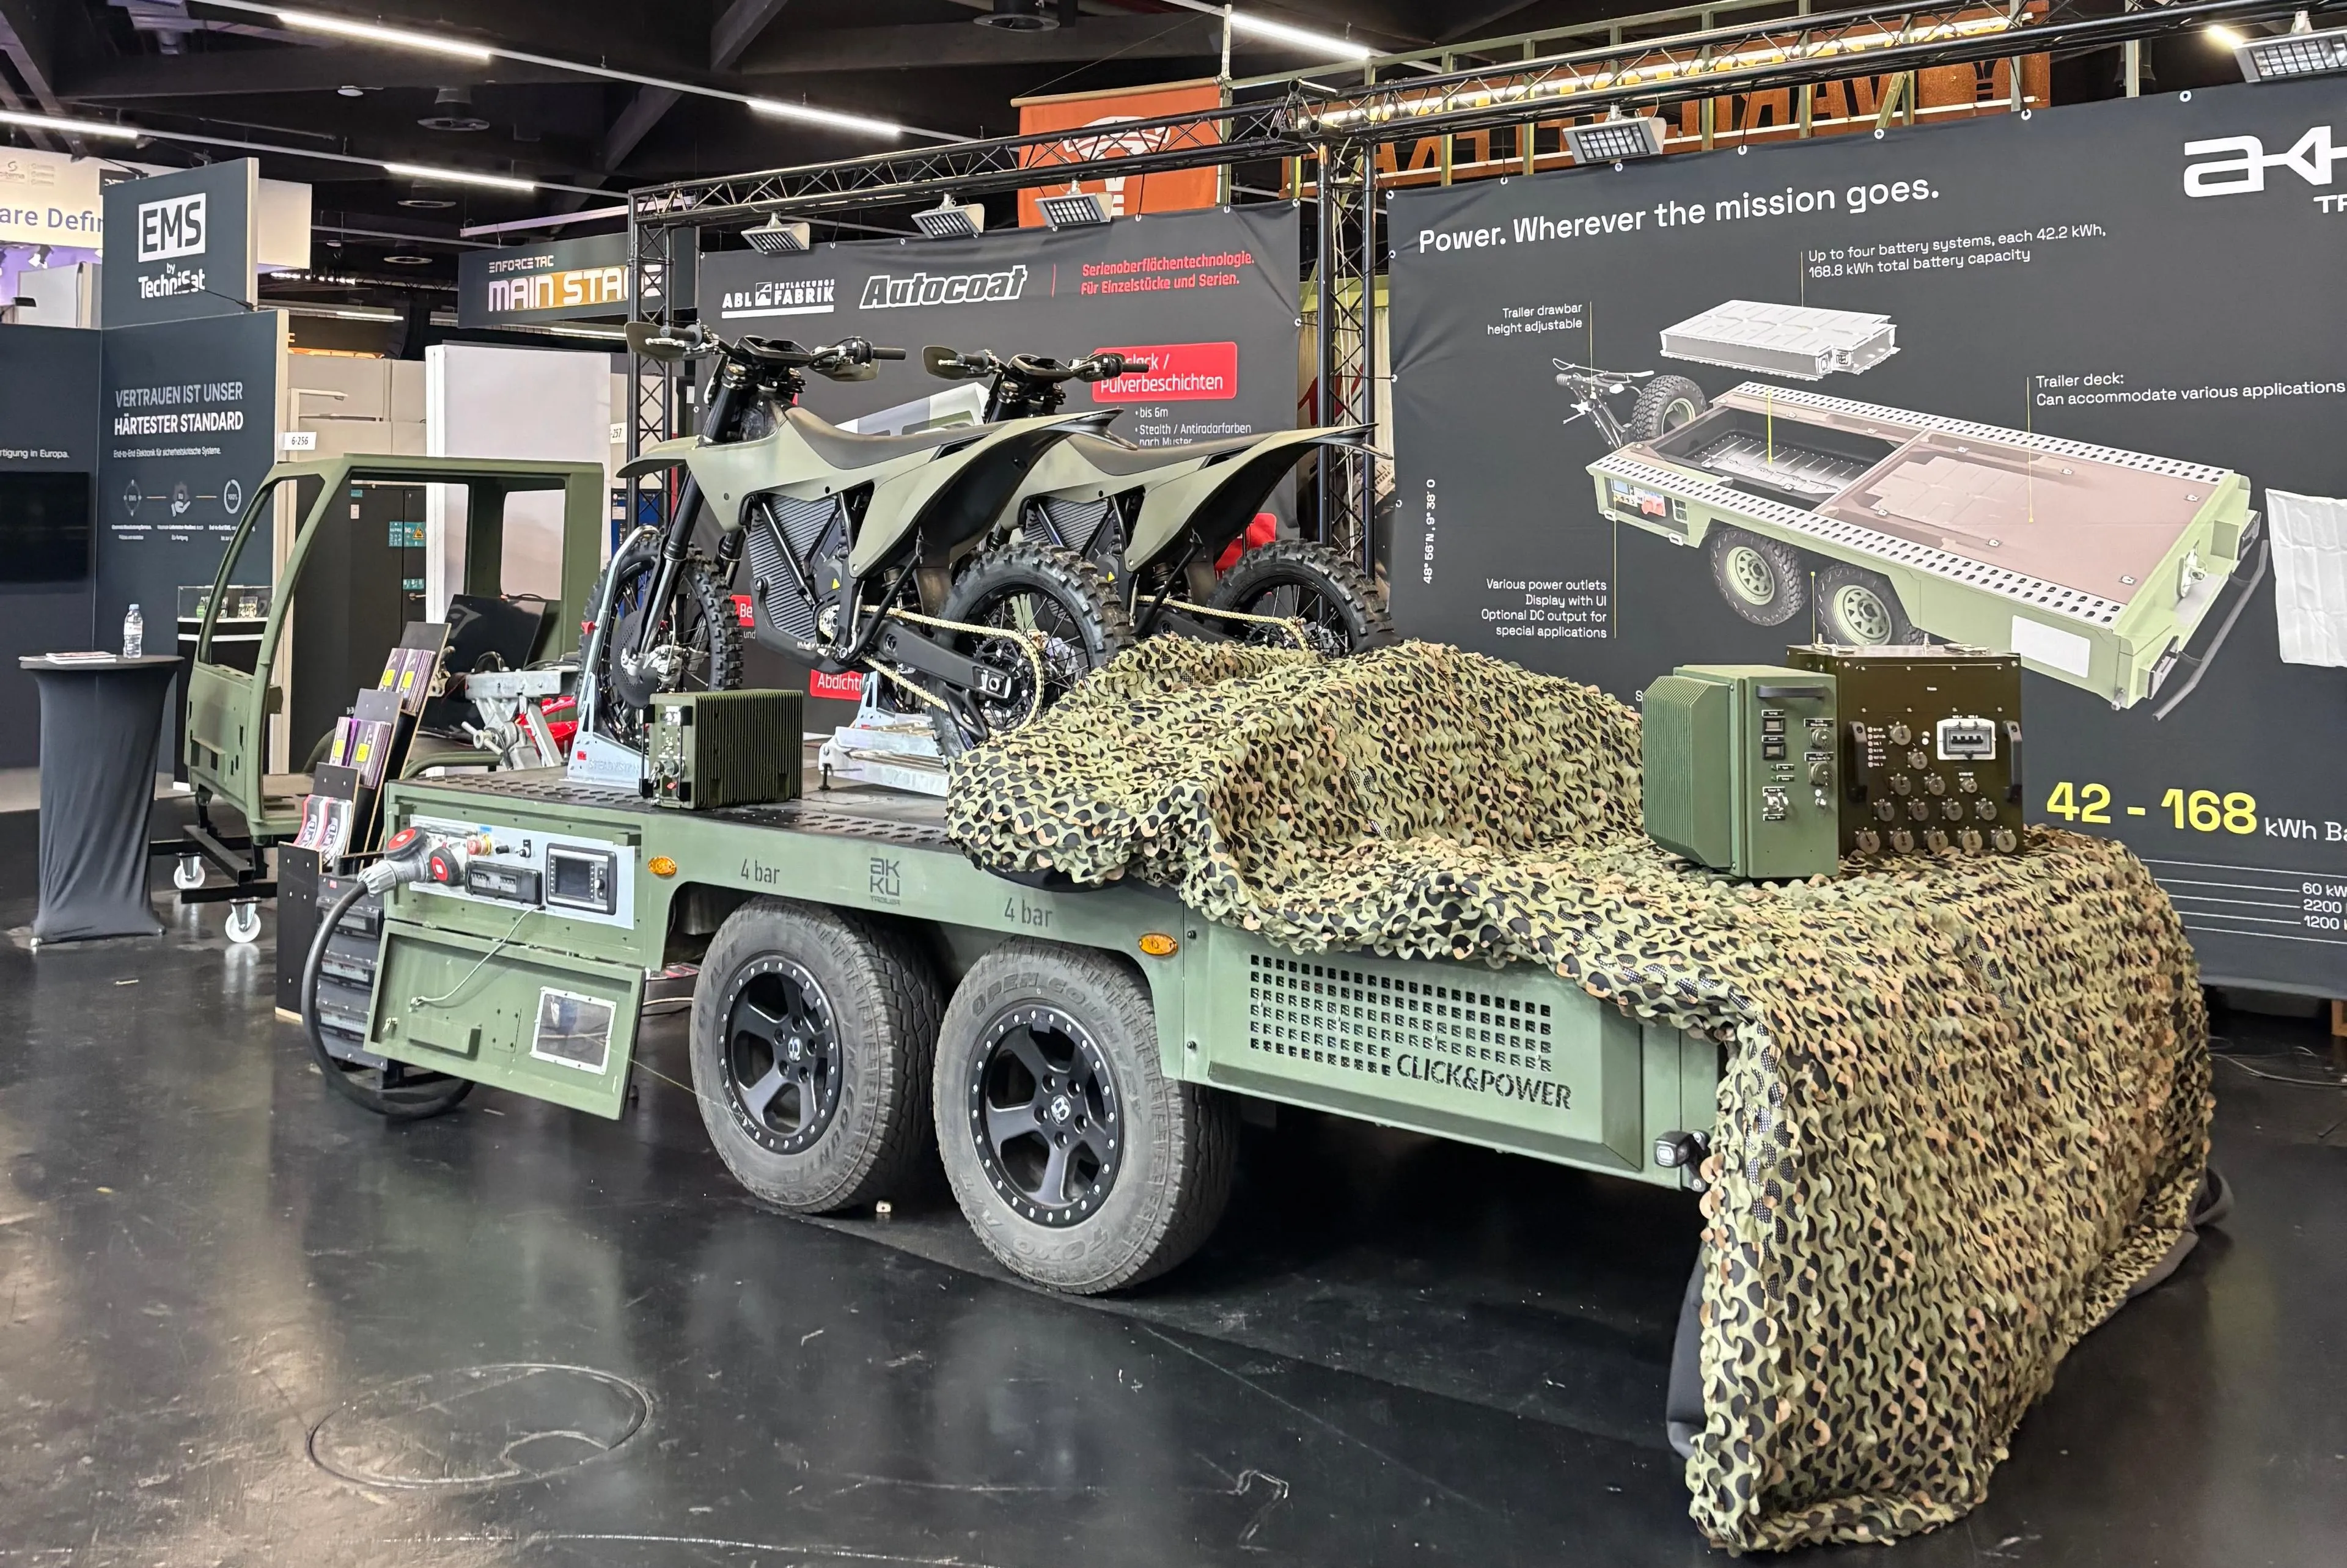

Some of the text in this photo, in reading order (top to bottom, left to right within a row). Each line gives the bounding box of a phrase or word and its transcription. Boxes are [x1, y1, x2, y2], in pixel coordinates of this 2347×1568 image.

[1419, 178, 1939, 254] Power. Wherever the mission goes.
[142, 200, 202, 254] EMS
[1808, 223, 2106, 263] Up to four battery systems, each 42.2 kWh,
[166, 262, 176, 274] by
[1082, 251, 1254, 276] Serienoberflächentechnologie.
[1809, 248, 2030, 279] 168.8 kWh total battery capacity
[138, 268, 205, 299] TechniSat
[488, 274, 554, 312] MAIN
[859, 265, 1029, 309] Autocoat
[1081, 272, 1240, 295] Für Einzelstücke und Serien.
[722, 286, 834, 309] ABL FABRIK
[1503, 304, 1582, 318] Trailer drawbar
[1488, 318, 1582, 335] height adjustable
[1101, 373, 1223, 394] Pulverbeschichten
[2036, 372, 2124, 388] Trailer deck:
[115, 381, 243, 408] VERTRAUEN IST UNSER
[2037, 381, 2345, 406] Can accommodate various applications
[1139, 407, 1168, 418] bis 6m
[114, 411, 243, 436] HÄRTESTER STANDARD
[611, 428, 622, 438] -257
[1139, 424, 1171, 435] Stealth
[1180, 422, 1251, 434] Antiradarfarben
[291, 436, 309, 446] 6-256
[31, 449, 38, 458] in
[40, 449, 70, 460] Europa.
[1486, 578, 1607, 593] Various power outlets
[740, 603, 753, 618] Be
[1526, 594, 1607, 608] Display with UI
[1482, 609, 1607, 625] Optional DC output for
[744, 630, 756, 639] und
[1496, 625, 1607, 640] special applications
[2047, 782, 2111, 824] 42
[2161, 788, 2258, 835] 168
[2264, 817, 2316, 840] kWh
[741, 859, 780, 885] 4 bar
[2302, 882, 2322, 895] 60
[1004, 896, 1053, 928] 4 bar
[2303, 899, 2342, 914] 2200
[2304, 915, 2340, 930] 1200
[1397, 1053, 1571, 1109] CLICK&POWER
